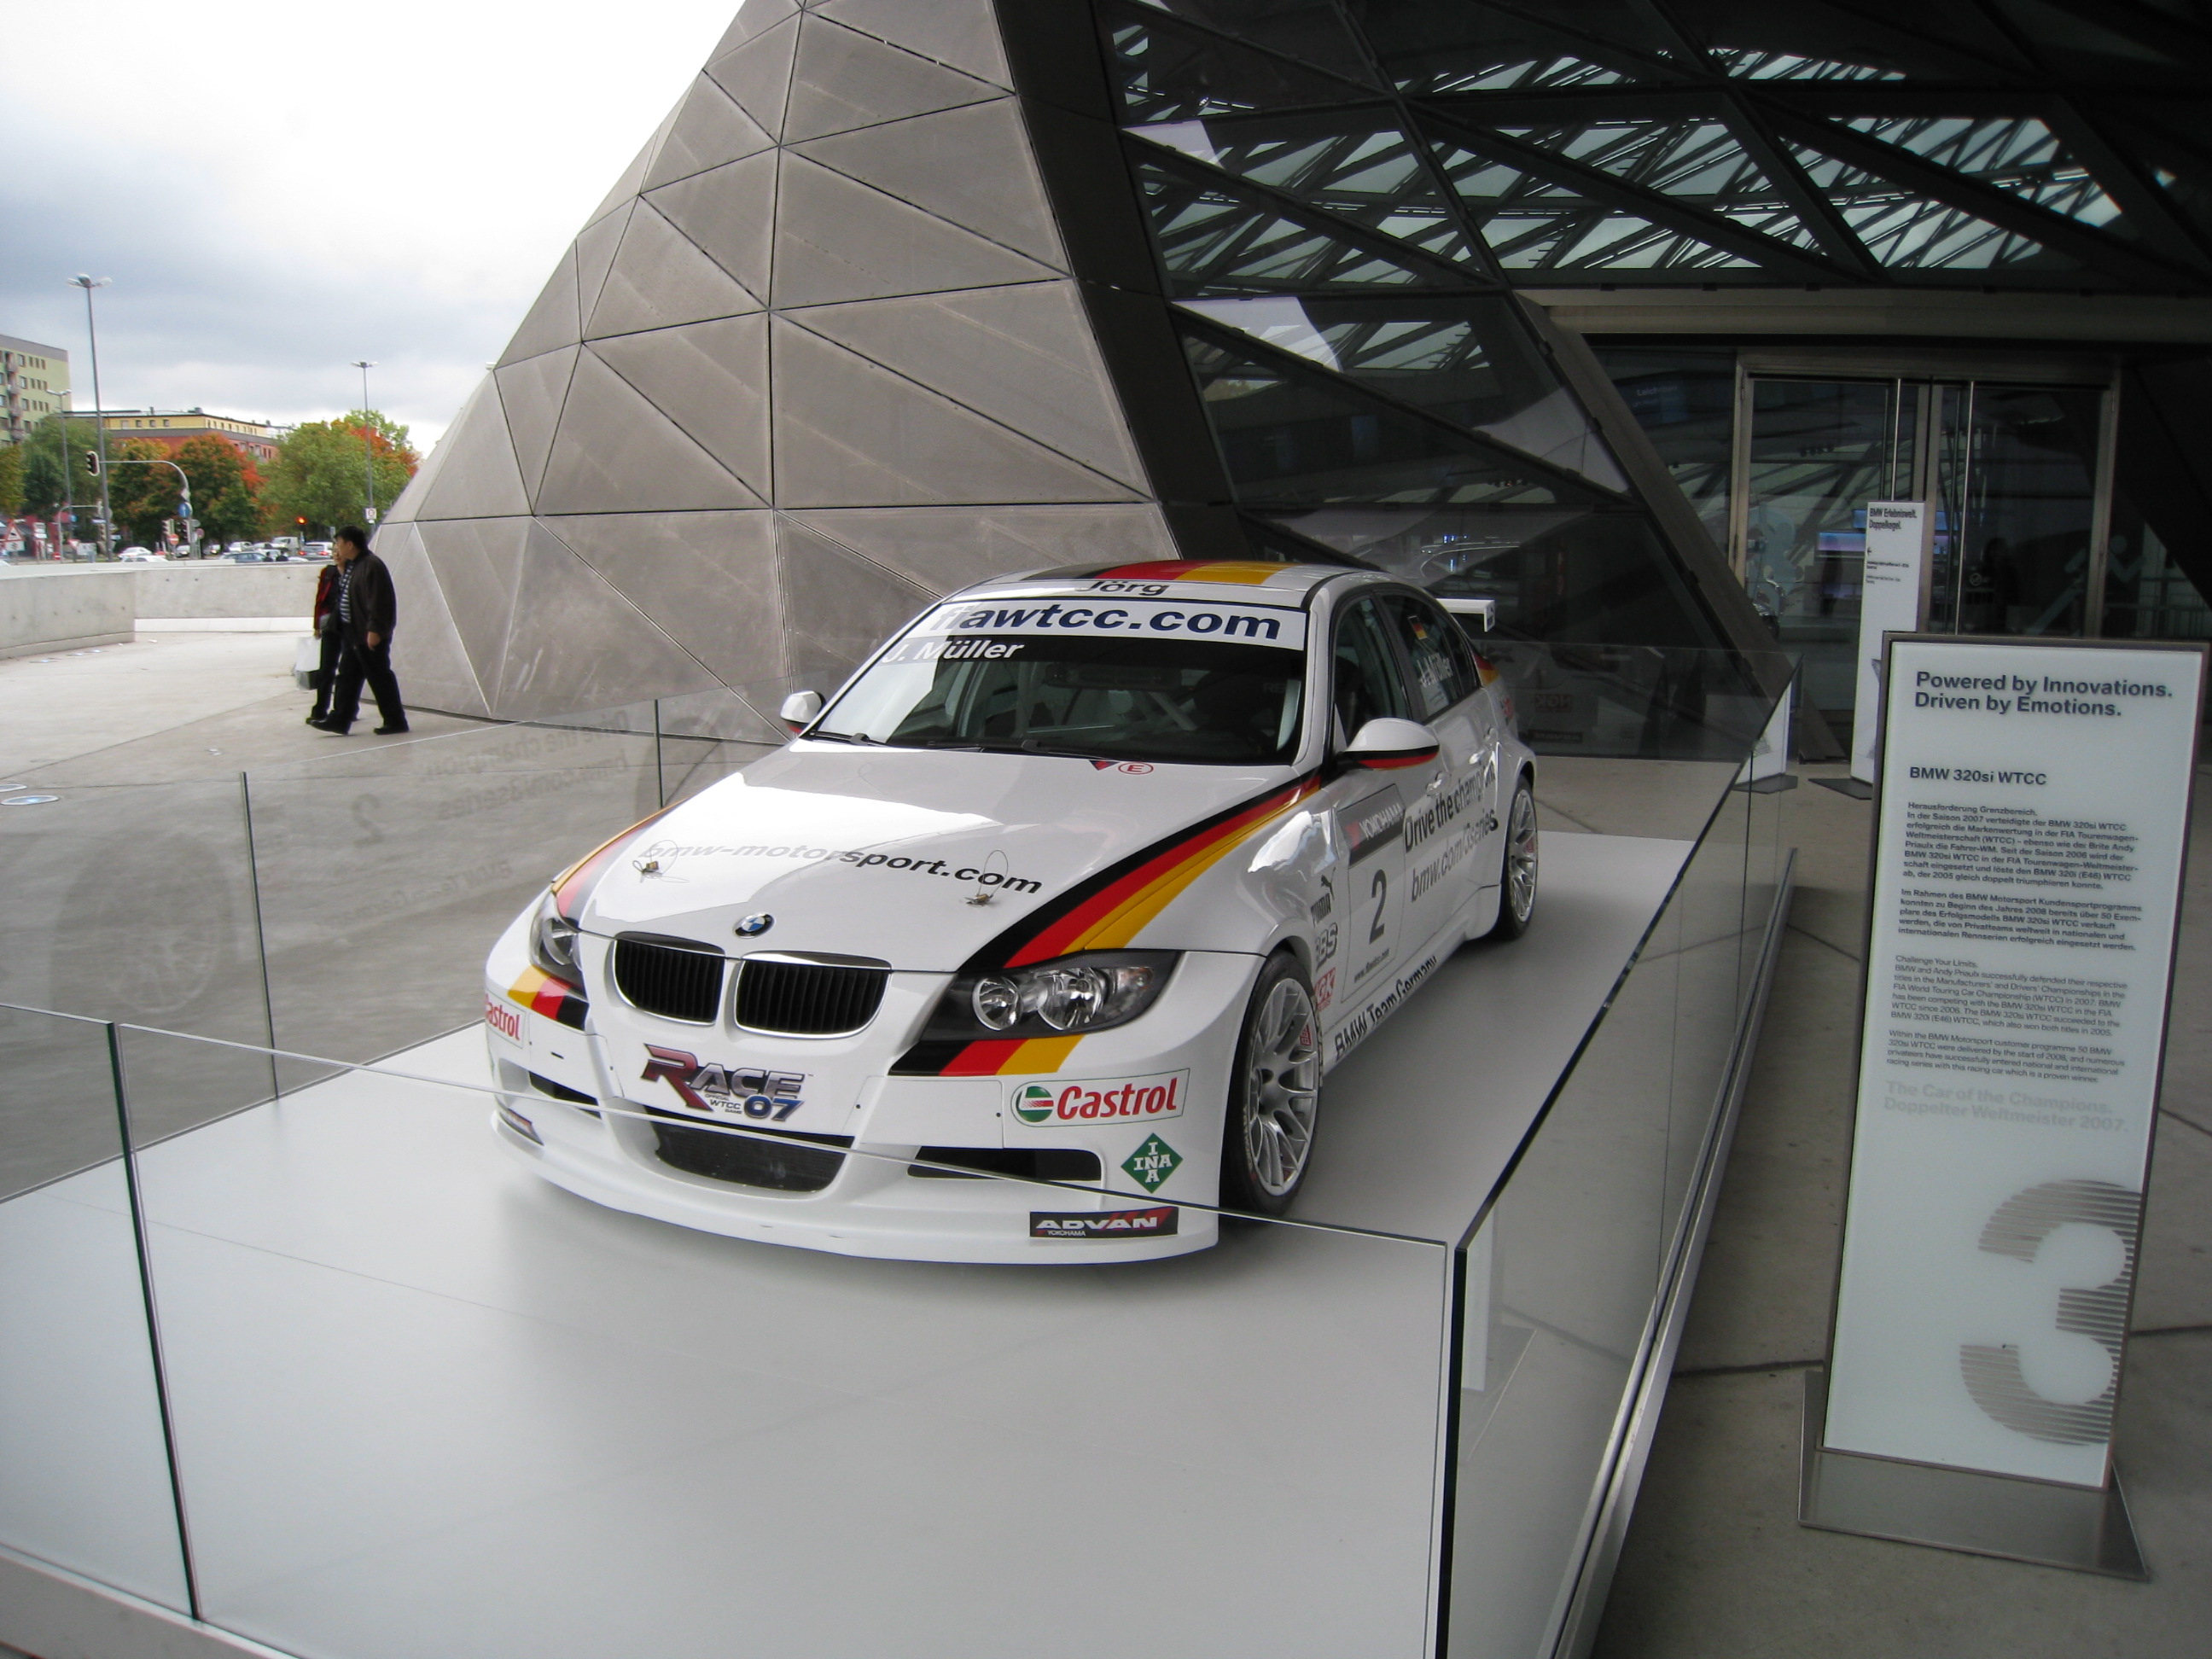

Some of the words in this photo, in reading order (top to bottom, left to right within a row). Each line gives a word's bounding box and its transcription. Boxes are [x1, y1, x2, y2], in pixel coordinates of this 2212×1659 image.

[1074, 580, 1170, 596] Jörg
[930, 604, 1280, 640] fiawtcc.com
[882, 643, 905, 663] J.
[913, 640, 1024, 660] Müller
[1915, 671, 2009, 690] Powered
[2012, 674, 2040, 696] by
[2043, 675, 2174, 697] Innovations.
[1913, 691, 1982, 710] Driven
[1986, 694, 2013, 715] by
[2017, 696, 2124, 716] Emotions.
[1909, 765, 1951, 781] BMW
[1953, 768, 1995, 783] 320si
[1998, 770, 2048, 786] WTCC
[1359, 803, 1404, 840] YOKOHAMA
[1404, 808, 1435, 853] Drive
[1435, 793, 1453, 828] the
[638, 844, 1043, 894] bmw-motorsport.com
[1369, 869, 1387, 945] 2
[1335, 1015, 1367, 1062] BMW
[1367, 993, 1397, 1023] Team
[641, 1043, 805, 1112] RACE
[710, 1099, 741, 1109] WTCC
[744, 1095, 805, 1121] 07
[1057, 1077, 1178, 1121] Castrol
[1133, 1154, 1173, 1171] INA
[1036, 1217, 1158, 1230] ADVAN
[1960, 1179, 2142, 1446] 3
